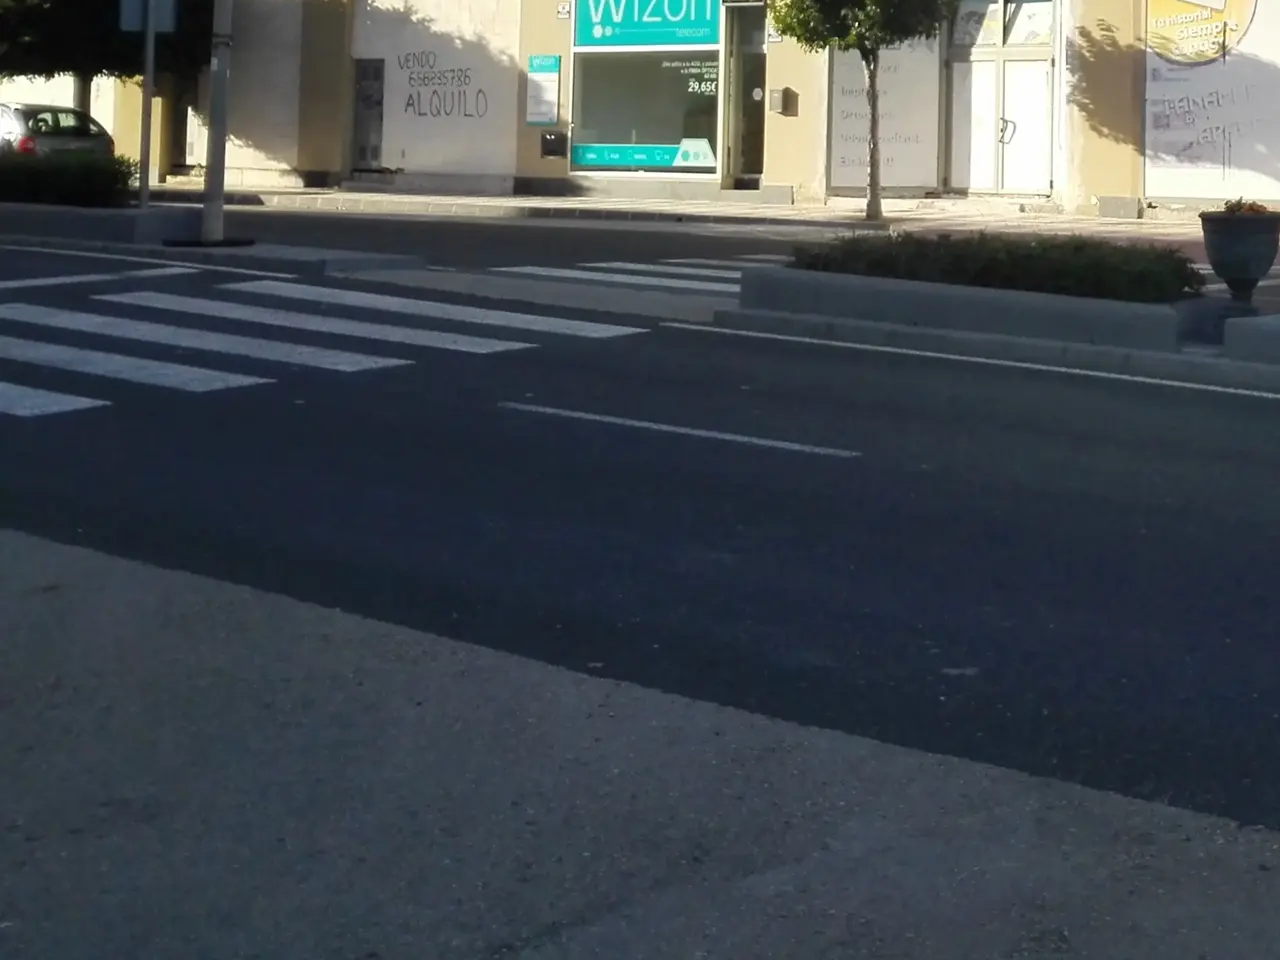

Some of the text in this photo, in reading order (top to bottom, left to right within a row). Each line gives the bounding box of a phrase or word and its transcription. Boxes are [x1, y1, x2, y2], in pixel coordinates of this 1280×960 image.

[397, 50, 437, 70] VENDO
[687, 81, 718, 94] 29,65€
[404, 88, 488, 118] ALQUILO
